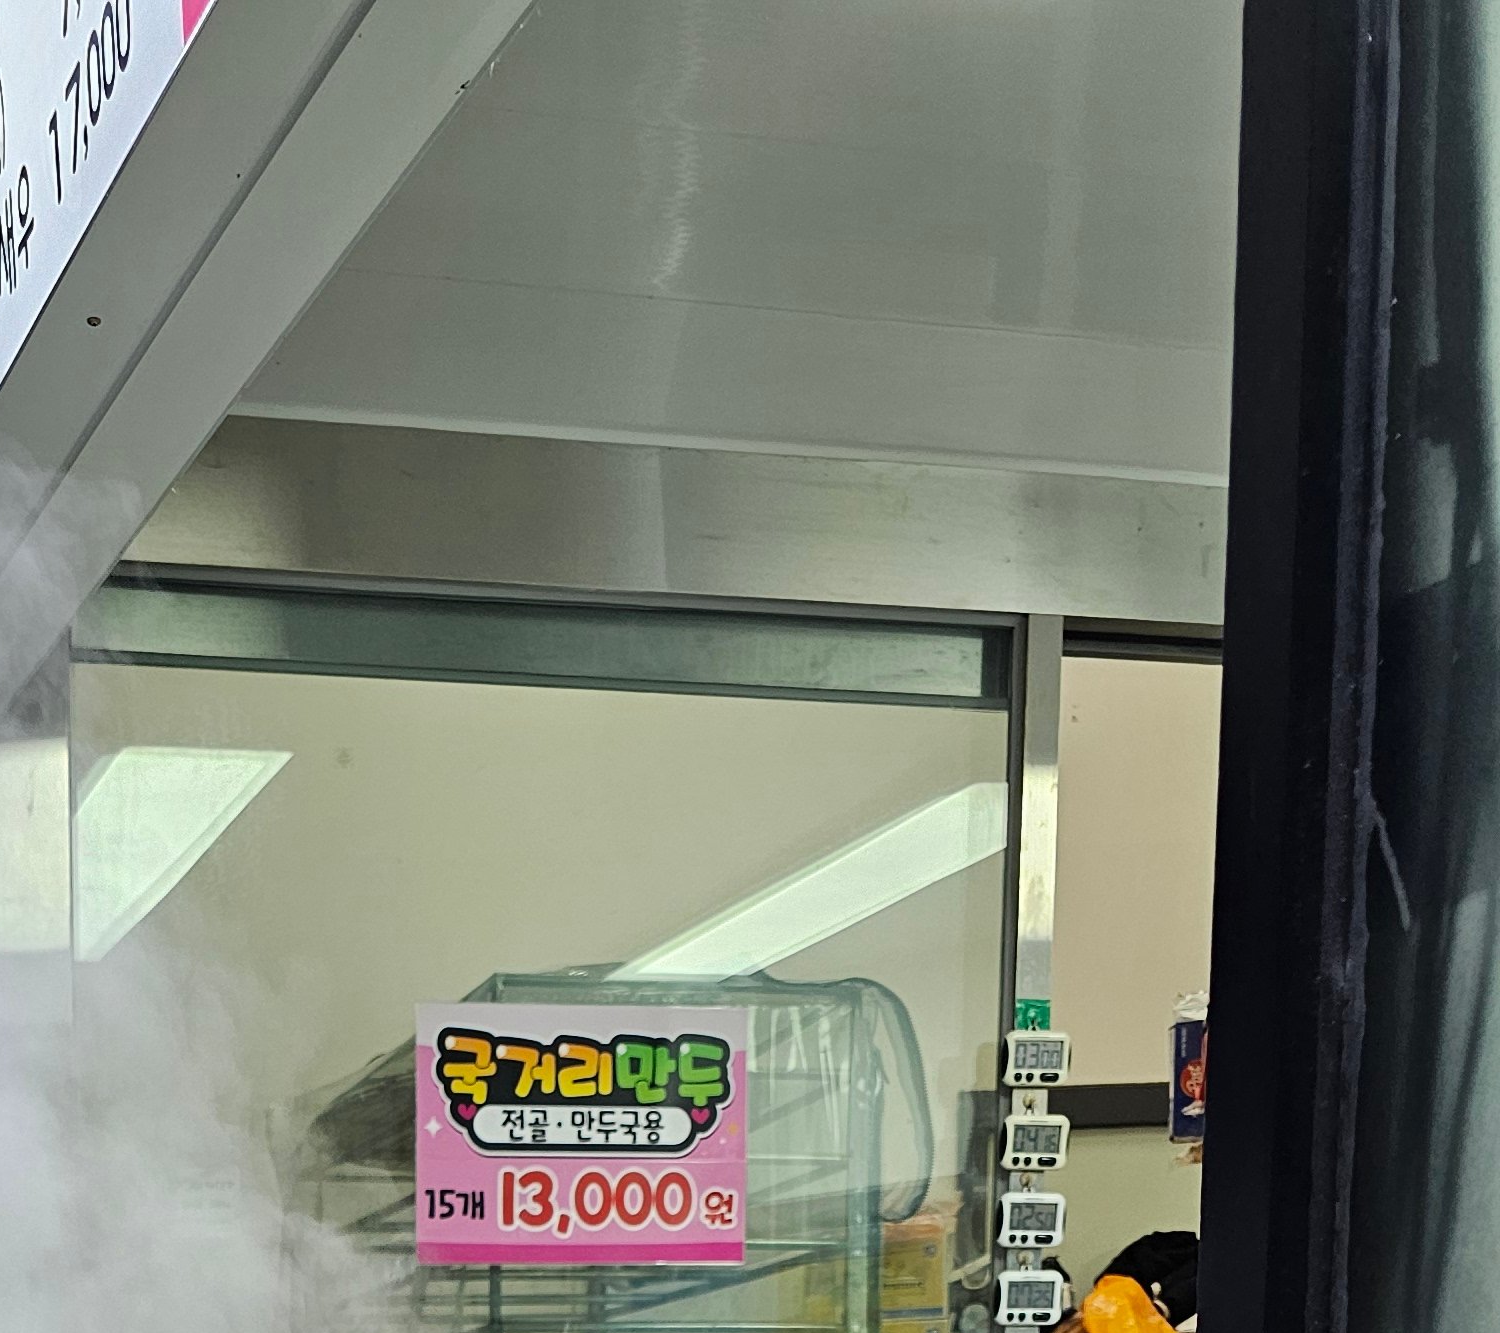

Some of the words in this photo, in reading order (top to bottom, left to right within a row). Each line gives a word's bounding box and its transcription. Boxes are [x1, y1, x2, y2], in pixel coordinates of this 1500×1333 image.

[48, 0, 131, 205] 17,000
[442, 1034, 726, 1107] 국거리만두
[424, 1189, 486, 1221] 15개
